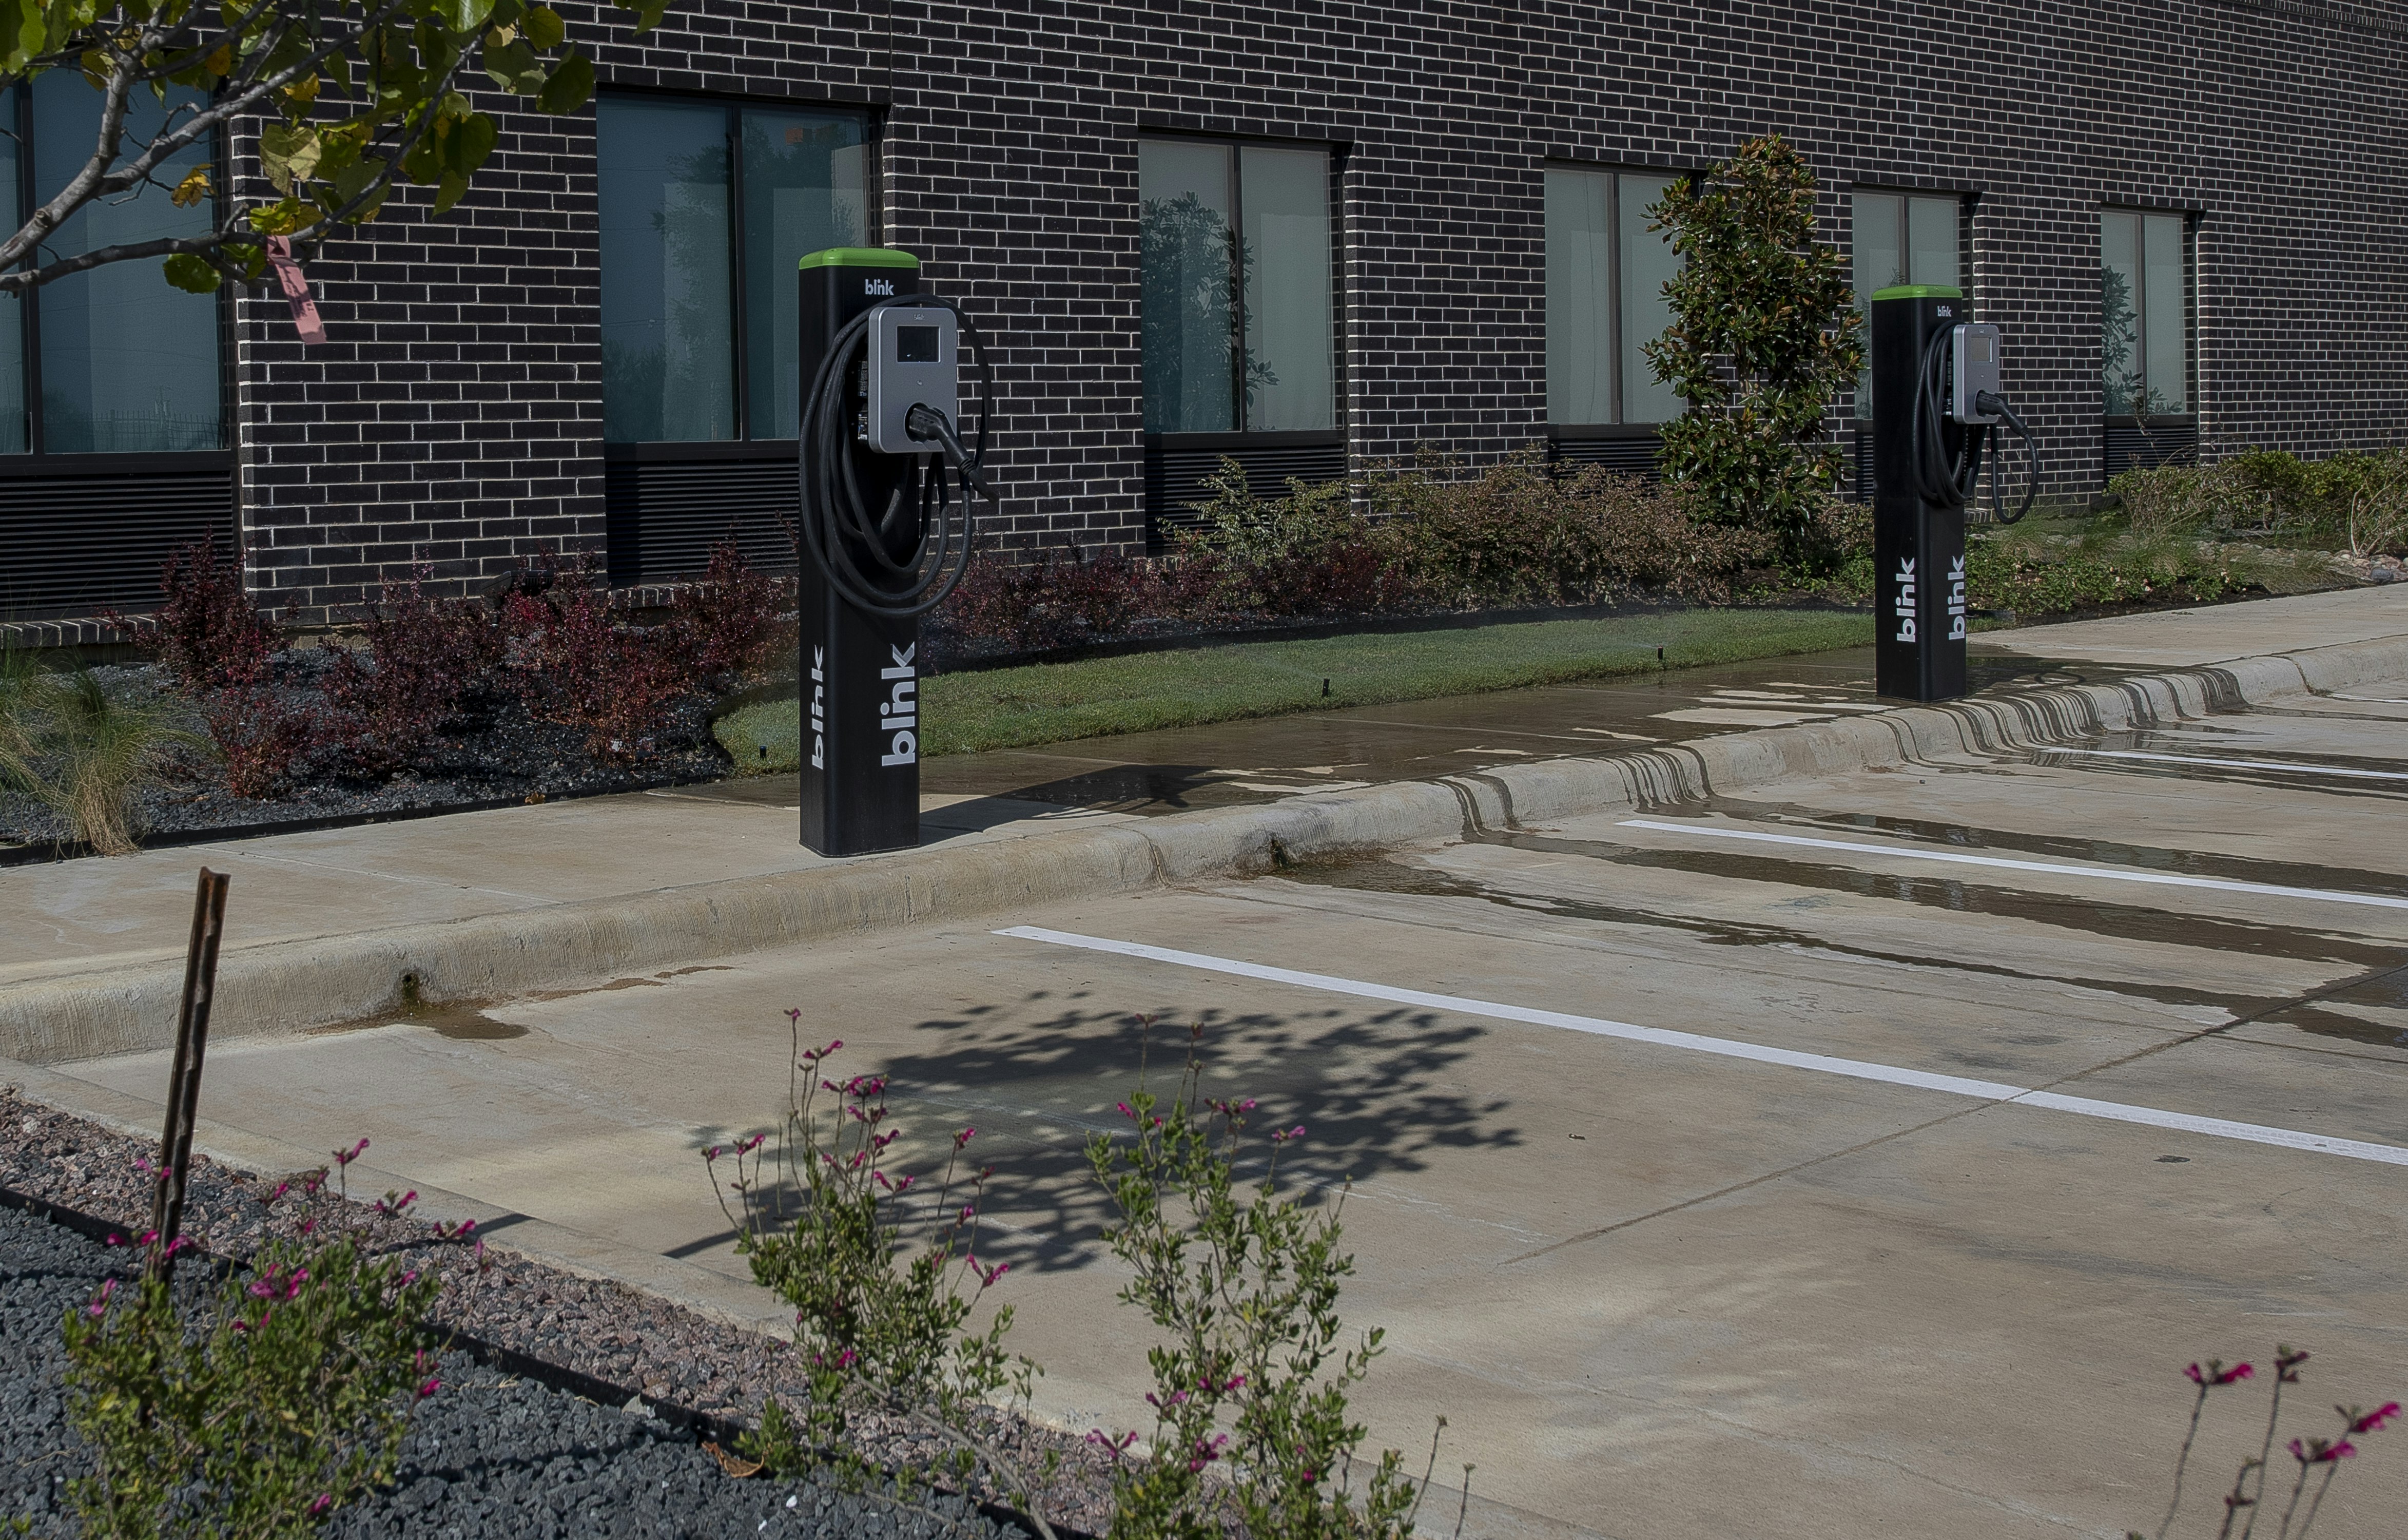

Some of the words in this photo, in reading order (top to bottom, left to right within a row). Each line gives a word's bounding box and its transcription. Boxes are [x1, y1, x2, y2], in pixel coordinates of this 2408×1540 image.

[865, 279, 894, 296] blink
[1937, 305, 1951, 317] blink
[1895, 557, 1915, 642] blink
[1948, 554, 1965, 640] blink
[811, 644, 823, 769] blink
[880, 641, 916, 766] blink
